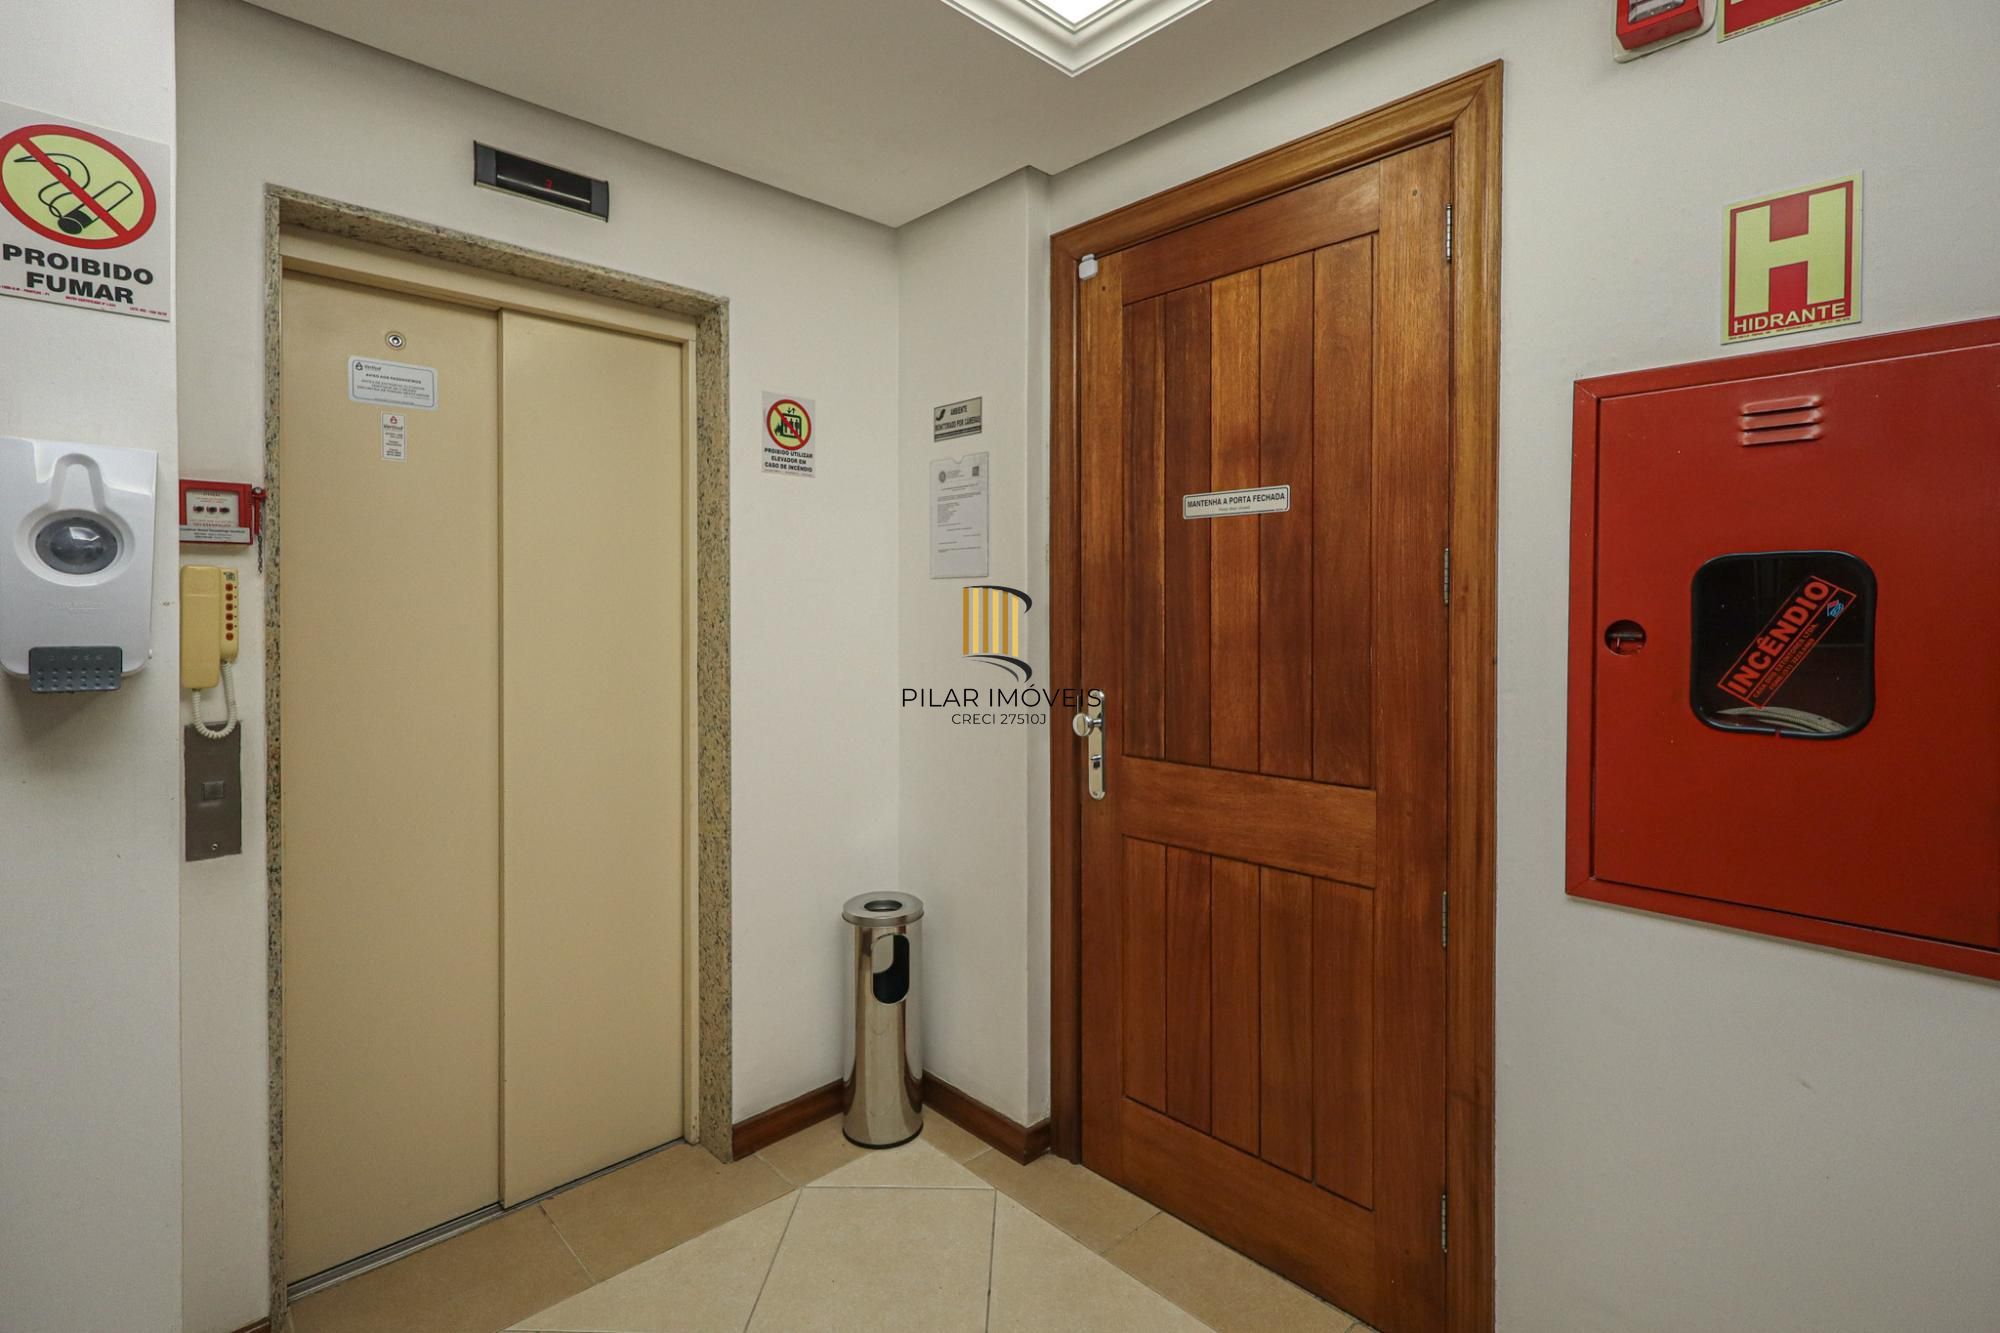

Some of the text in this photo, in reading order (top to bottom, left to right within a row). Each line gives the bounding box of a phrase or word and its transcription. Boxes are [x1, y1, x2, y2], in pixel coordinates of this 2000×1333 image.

[2, 243, 154, 285] PROIBIDO
[1735, 187, 1846, 317] H
[26, 271, 134, 304] FUMAR
[1733, 302, 1846, 334] HIDRANTE
[764, 447, 813, 459] PROIBIDO UTILIZAR
[764, 461, 780, 469] CASO
[771, 455, 798, 464] ELEVADOR
[1187, 498, 1222, 508] MANTENHA
[1229, 495, 1252, 505] PORTA
[1252, 492, 1285, 503] FECHADA
[1726, 581, 1830, 695] INCÊNDIO
